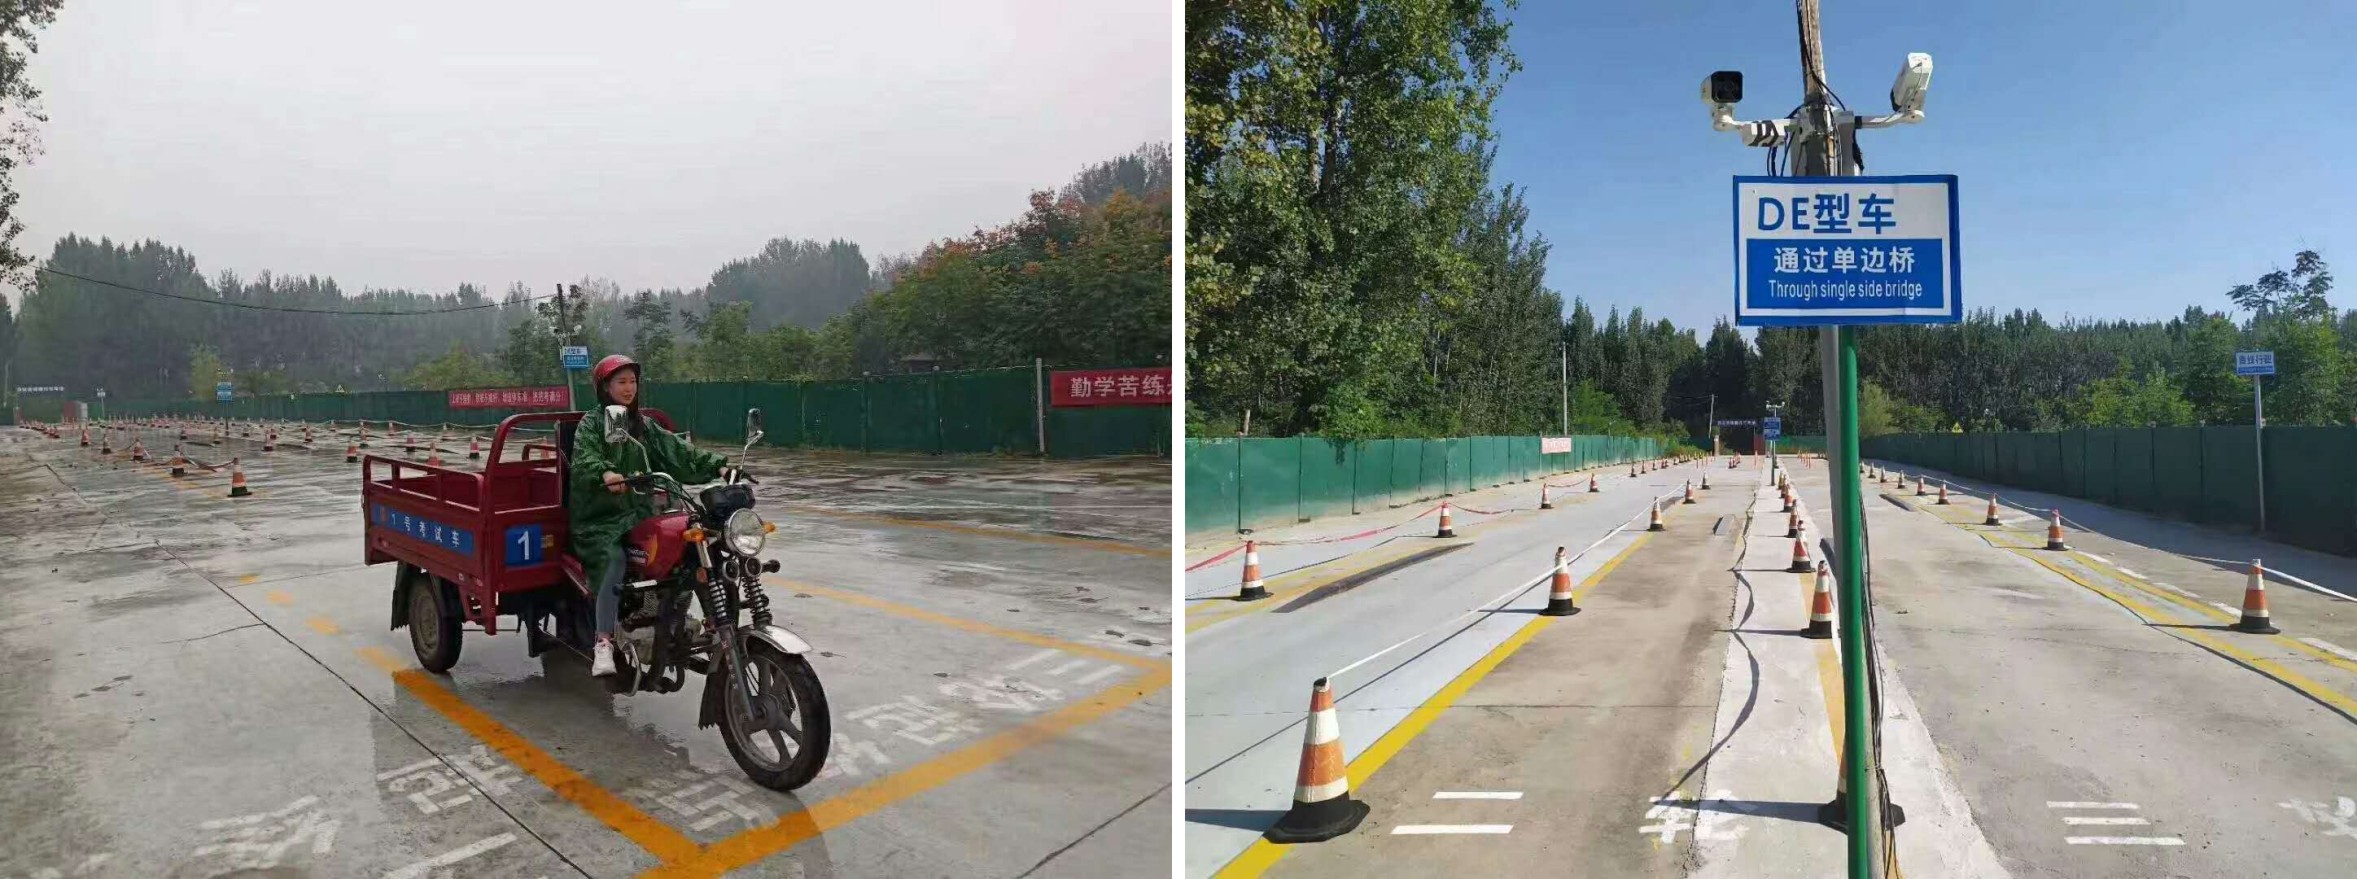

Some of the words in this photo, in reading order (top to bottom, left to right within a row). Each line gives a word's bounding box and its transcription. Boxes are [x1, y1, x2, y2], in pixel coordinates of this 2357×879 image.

[1758, 193, 1896, 235] DE型车
[1774, 246, 1916, 274] 通过单边桥
[1769, 279, 1818, 301] Through
[1821, 280, 1856, 300] single
[1858, 279, 1883, 298] side
[1885, 279, 1923, 300] bridge
[1070, 374, 1171, 397] 勤学苦练
[518, 530, 530, 561] 1
